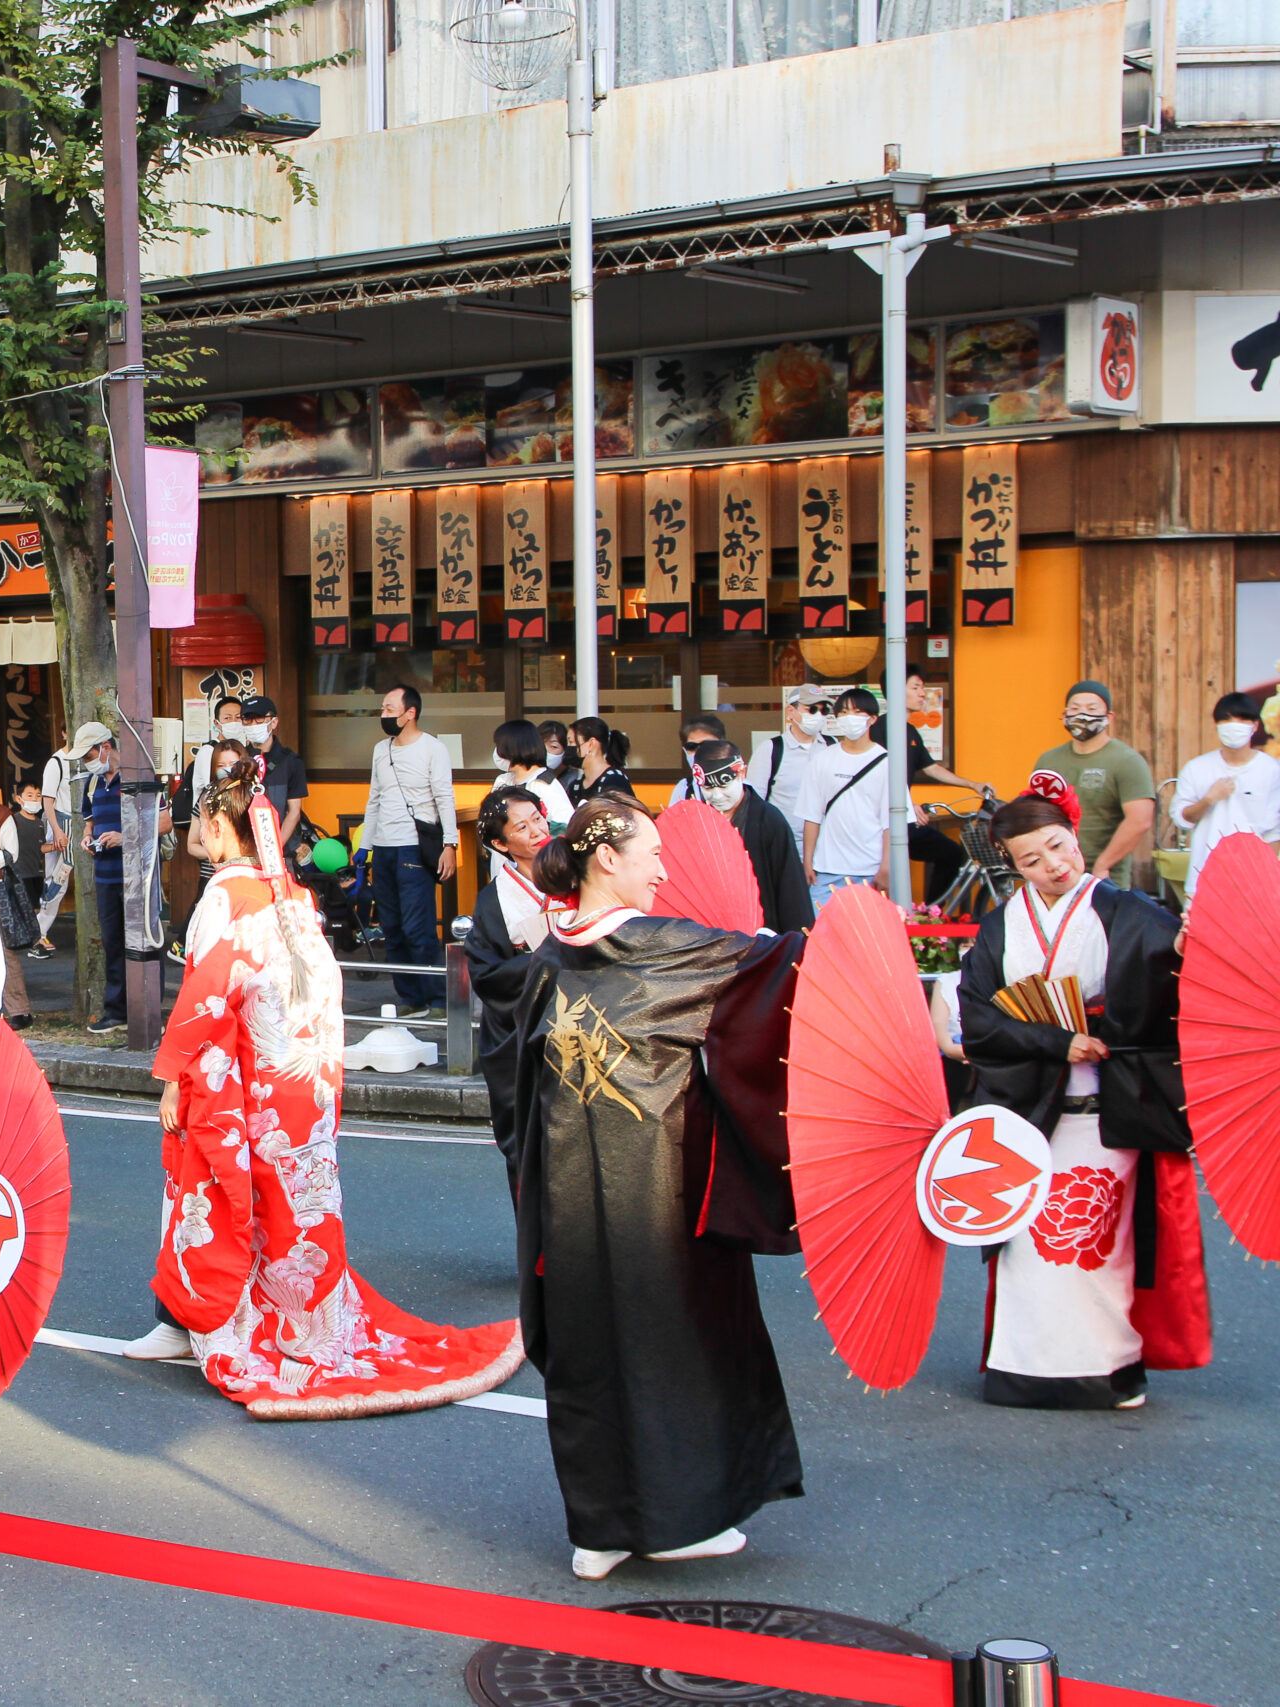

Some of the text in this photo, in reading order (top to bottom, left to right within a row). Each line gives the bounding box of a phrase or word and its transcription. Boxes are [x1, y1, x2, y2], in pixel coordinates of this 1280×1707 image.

[723, 493, 764, 575] からあげ
[802, 487, 843, 588] うどん
[827, 488, 845, 536] 季節の
[965, 472, 1008, 577] かつ丼
[995, 475, 1014, 533] こだわり
[313, 521, 342, 611] かつ丼
[328, 522, 346, 573] こだわり
[375, 516, 407, 607] みそかつ丼
[438, 511, 475, 588] ひれかつ
[649, 498, 687, 595] かつカレー
[725, 572, 759, 593] 定食
[441, 587, 471, 605] 定食
[510, 583, 541, 602] 定食
